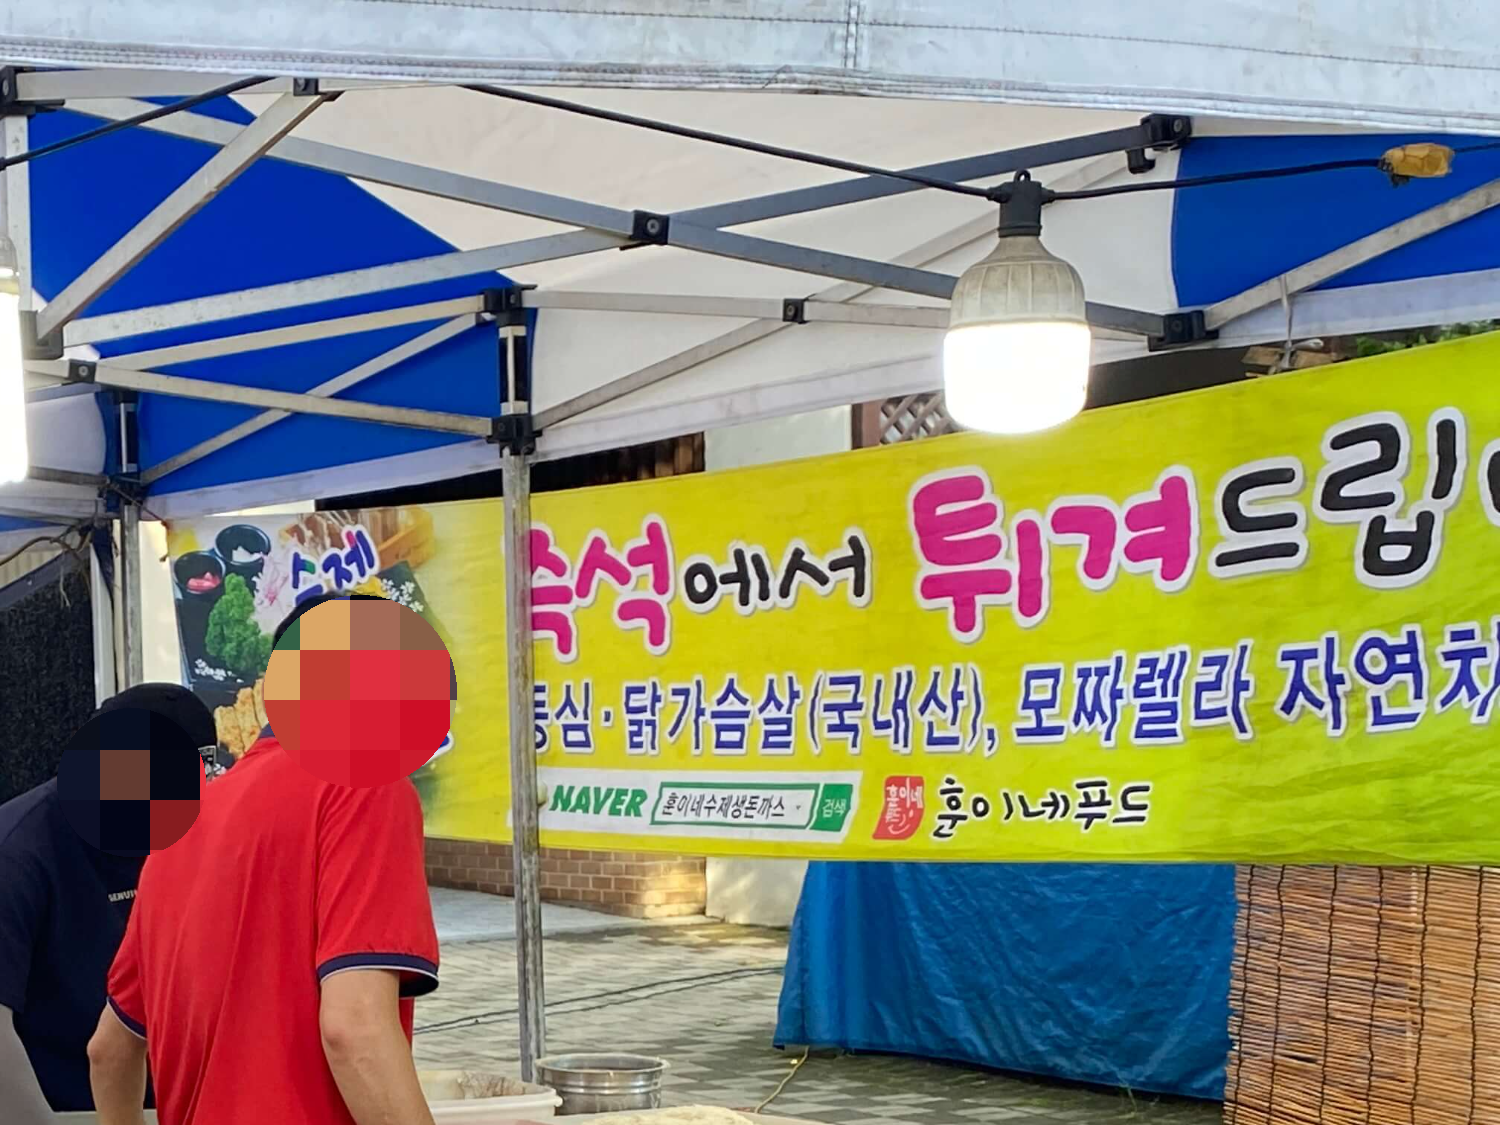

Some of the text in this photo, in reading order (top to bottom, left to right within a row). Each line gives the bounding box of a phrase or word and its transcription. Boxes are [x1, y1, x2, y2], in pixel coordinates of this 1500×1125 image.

[913, 419, 1500, 633] 튀겨드립
[1017, 645, 1250, 741] 모짜렐라
[550, 785, 648, 817] NAVER
[821, 798, 847, 817] 검색
[932, 777, 1151, 838] 훈이네푸드
